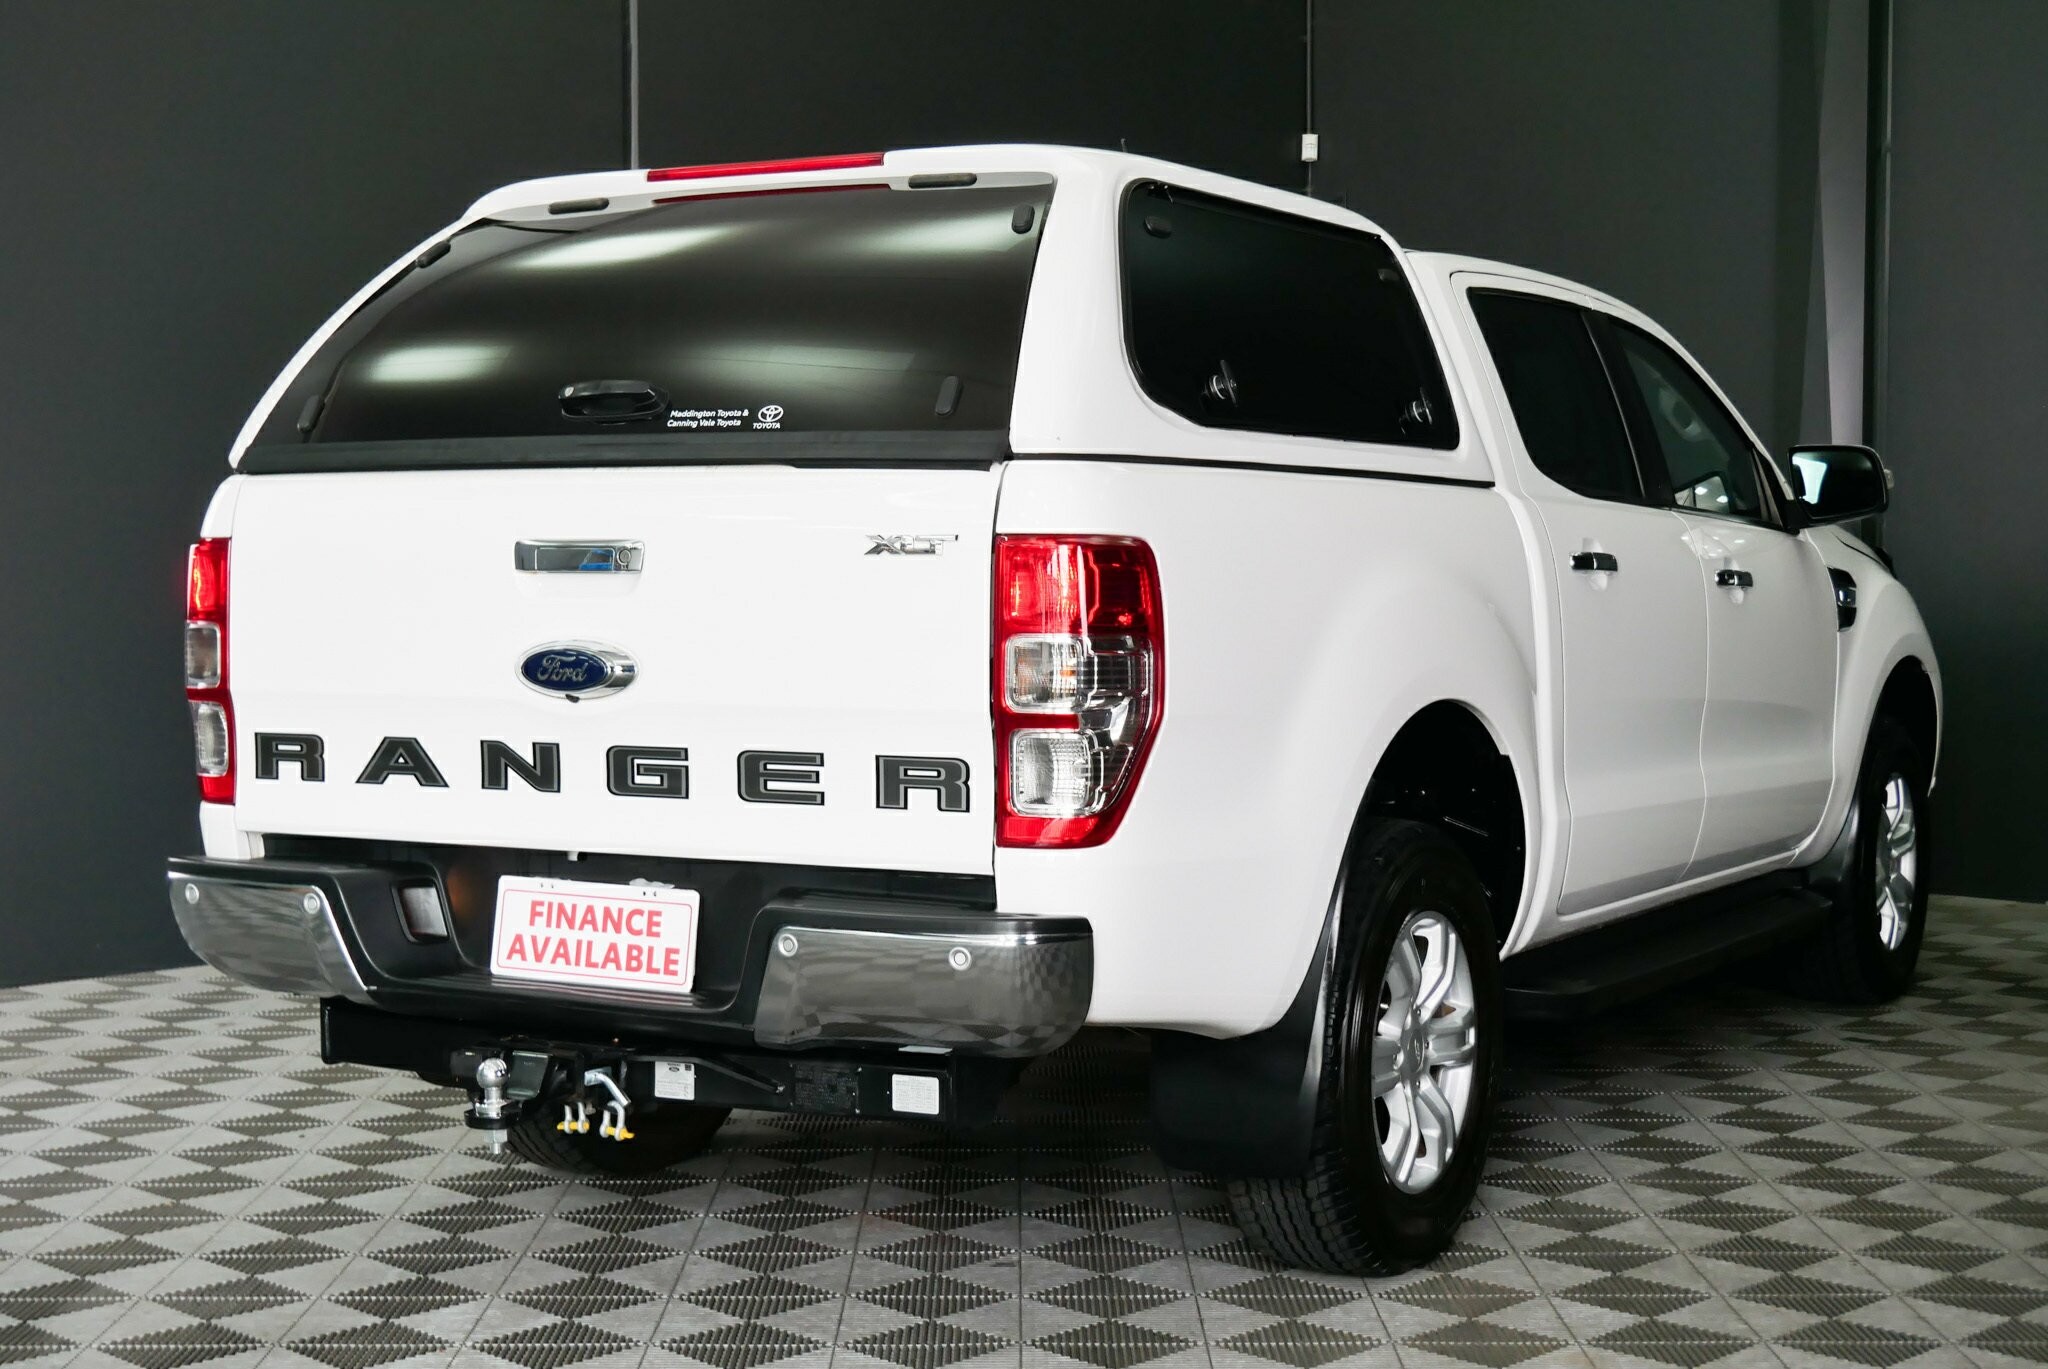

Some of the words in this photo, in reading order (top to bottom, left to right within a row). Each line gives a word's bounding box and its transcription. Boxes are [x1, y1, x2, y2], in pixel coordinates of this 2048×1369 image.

[667, 419, 698, 428] Canning
[699, 419, 715, 427] Vale
[716, 419, 742, 428] Toyota
[670, 410, 716, 418] Maddington
[717, 409, 742, 418] Toyota
[742, 409, 749, 417] &
[753, 422, 781, 430] TOYOTA
[864, 534, 959, 555] XLT
[536, 654, 588, 683] Ford
[254, 731, 971, 814] RANGER
[528, 899, 663, 938] FINANCE
[506, 933, 681, 977] AVAILABLE
